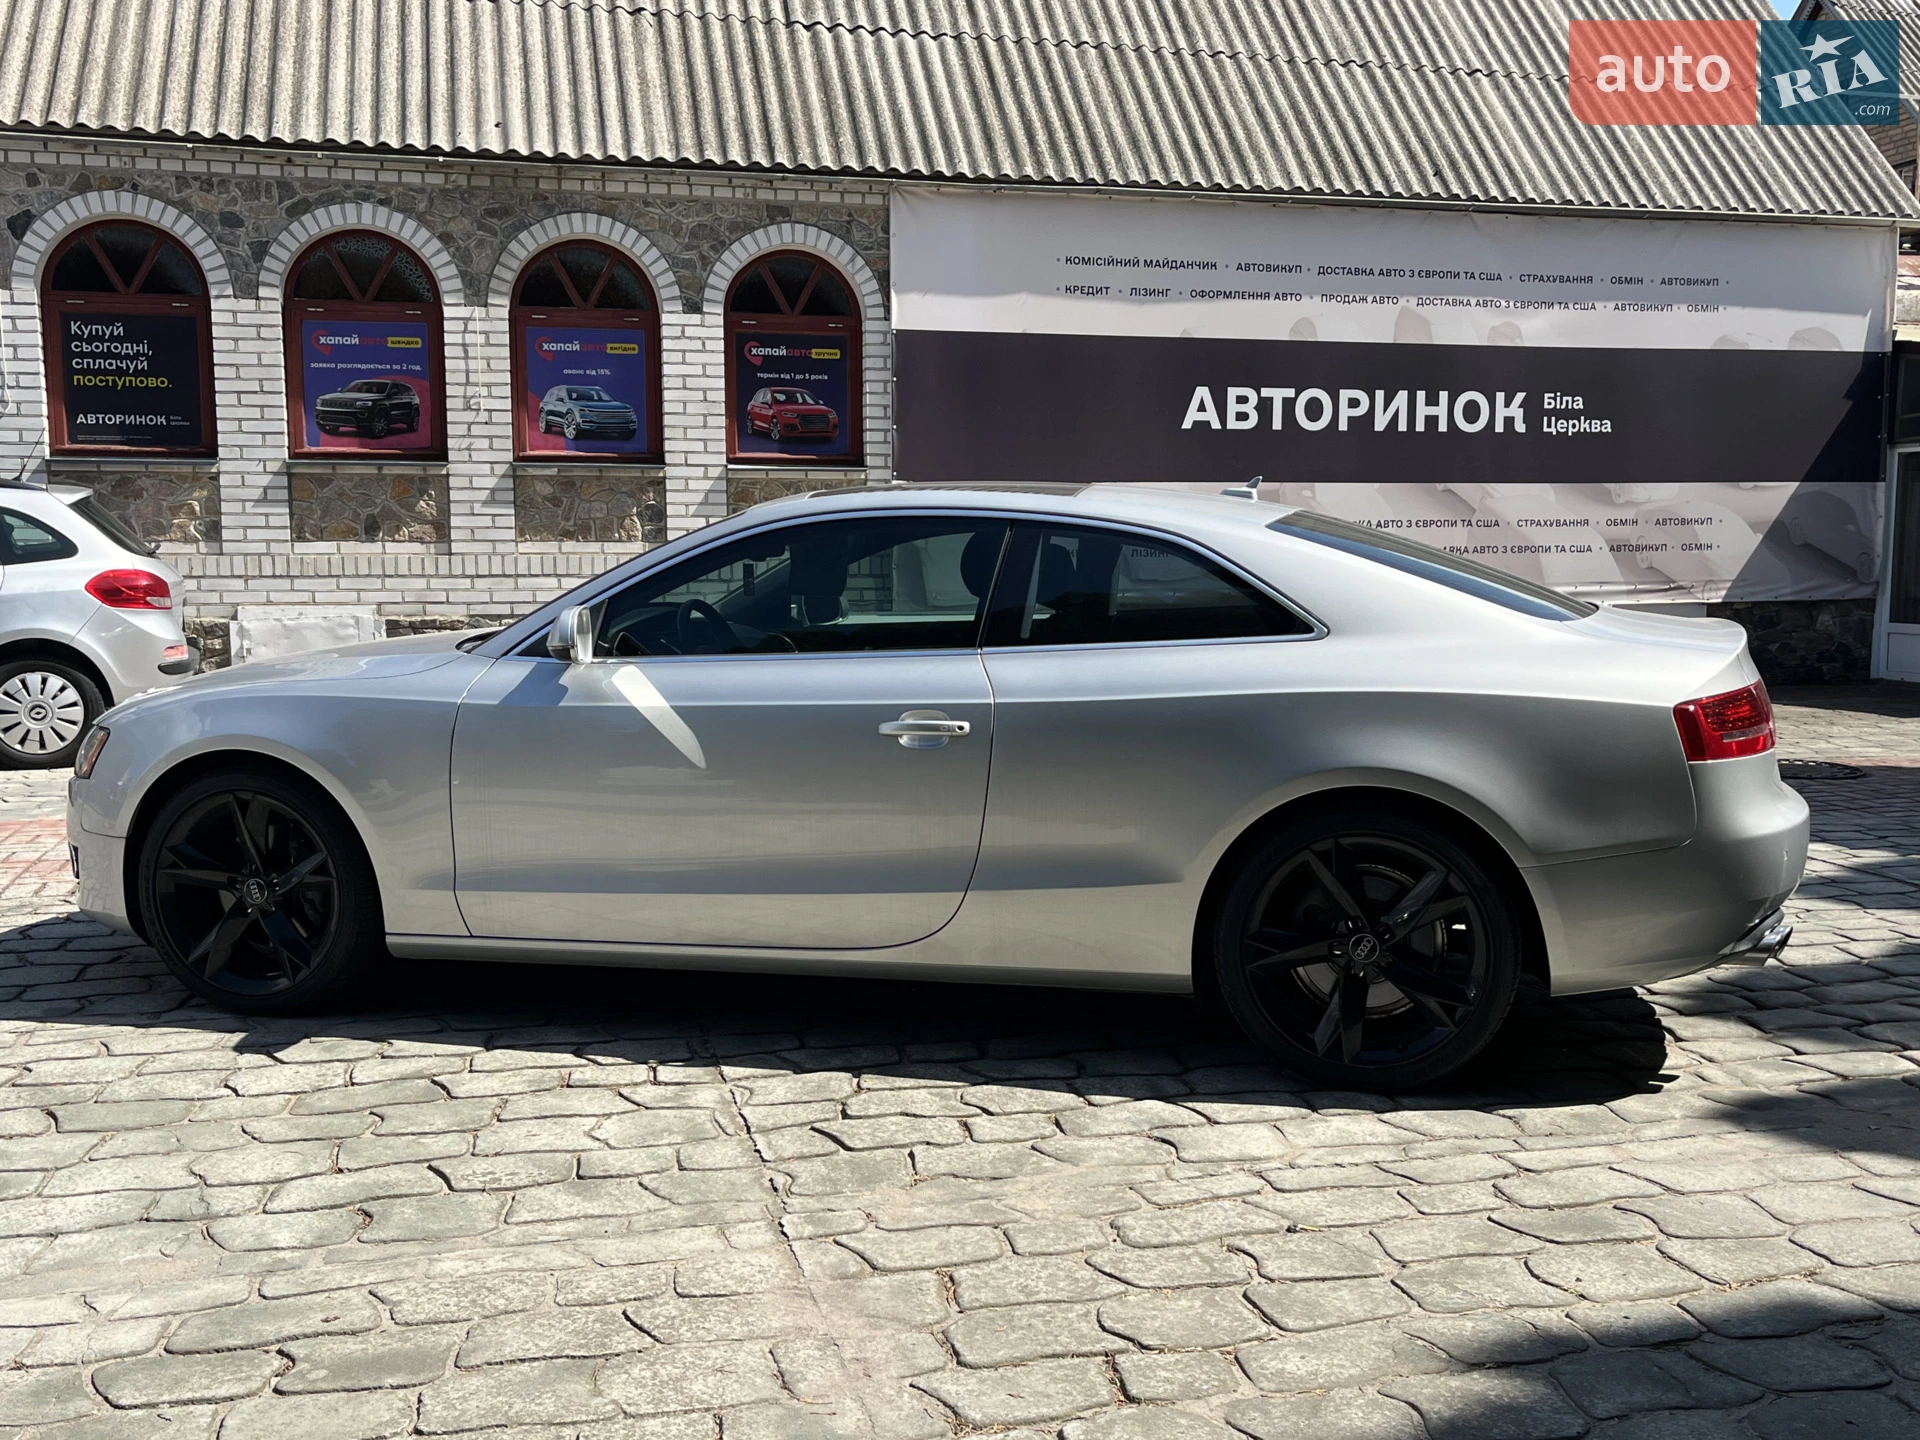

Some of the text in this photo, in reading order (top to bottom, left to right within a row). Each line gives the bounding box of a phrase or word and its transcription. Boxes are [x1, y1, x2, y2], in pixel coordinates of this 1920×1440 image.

[1066, 256, 1719, 286] КОМІСІЙНИЙ МАЙДАНЧИК АВТОВИКУП ДОСТАВКА АВТО З ЄВРОПИ ТА США СТРАХУВАННЯ ОБМІН АВТОВИКУП
[1065, 285, 1719, 313] КРЕДИТ ЛІЗИНГ ОФОРМЛЕННЯ АВТО ПРОДАЖ АВТО ДОСТАВКА АВТО З ЄВРОПИ ТА США АВТОВИКУП ОБМІН
[71, 321, 124, 339] Купуй
[71, 340, 152, 355] сьогодні,
[72, 357, 148, 373] сплачуй
[74, 375, 172, 389] поступово.
[1181, 386, 1526, 432] АВТОРИНОК
[1543, 393, 1584, 410] Біла
[77, 414, 166, 425] АВТОРИНОК
[1543, 416, 1611, 435] Церква
[1376, 520, 1403, 529] АВТО
[1406, 520, 1412, 528] З
[1415, 520, 1457, 528] ЄВРОПИ
[1461, 519, 1473, 527] ТА
[1476, 519, 1500, 527] США
[1517, 519, 1589, 527] СТРАХУВАННЯ
[1606, 518, 1638, 526] ОБМІН
[1655, 517, 1712, 526] АВТОВИКУП
[1472, 546, 1499, 554] АВТО
[1510, 545, 1551, 553] ЄВРОПИ
[1554, 545, 1566, 553] ТА
[1569, 545, 1592, 553] США
[1609, 544, 1667, 554] АВТОВИКУП
[1681, 543, 1712, 551] ОБМІН
